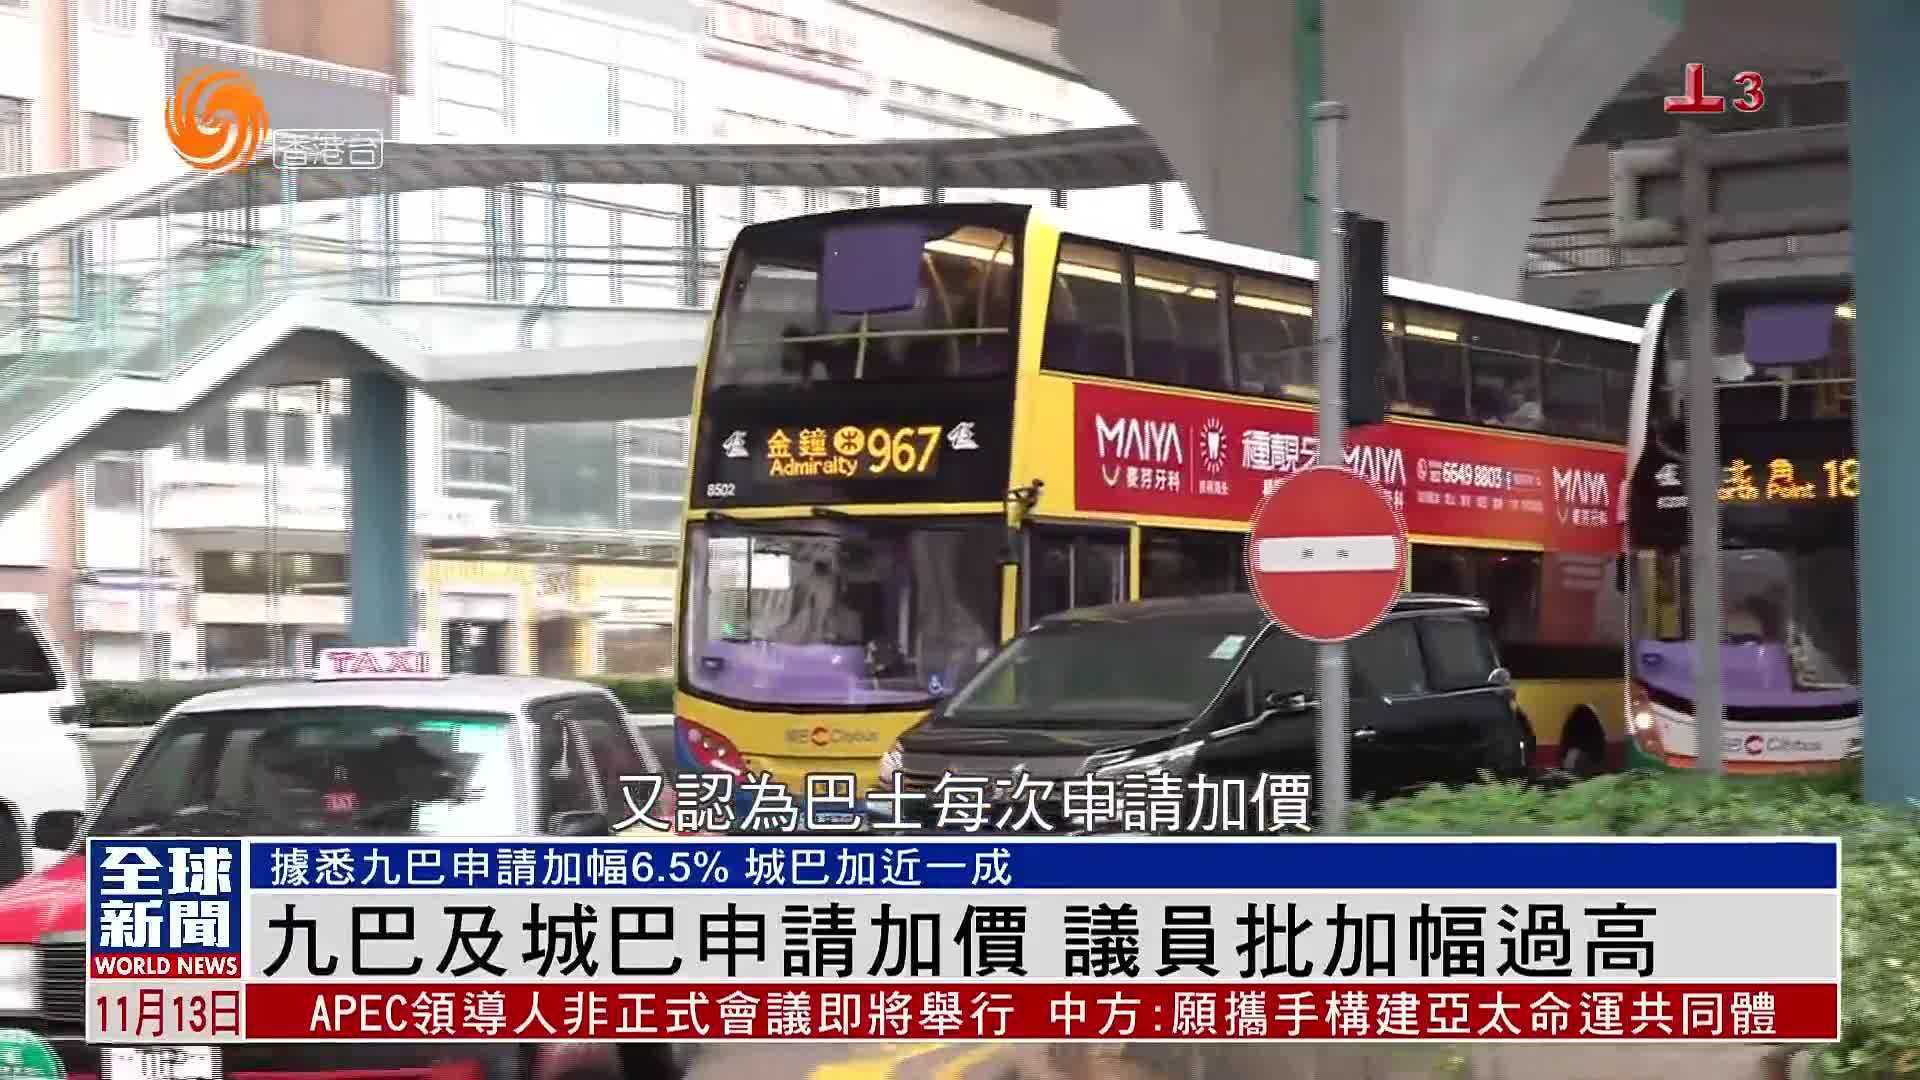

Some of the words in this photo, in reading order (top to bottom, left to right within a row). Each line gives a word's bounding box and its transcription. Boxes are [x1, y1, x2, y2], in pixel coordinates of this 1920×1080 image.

[768, 428, 827, 457] 金鐘
[867, 426, 942, 473] 967
[1096, 413, 1183, 464] MAIYA
[770, 457, 858, 478] Admiralty
[707, 482, 735, 497] 8502
[1716, 484, 1760, 501] orth
[1766, 482, 1817, 500] Point
[328, 651, 431, 673] TAXI
